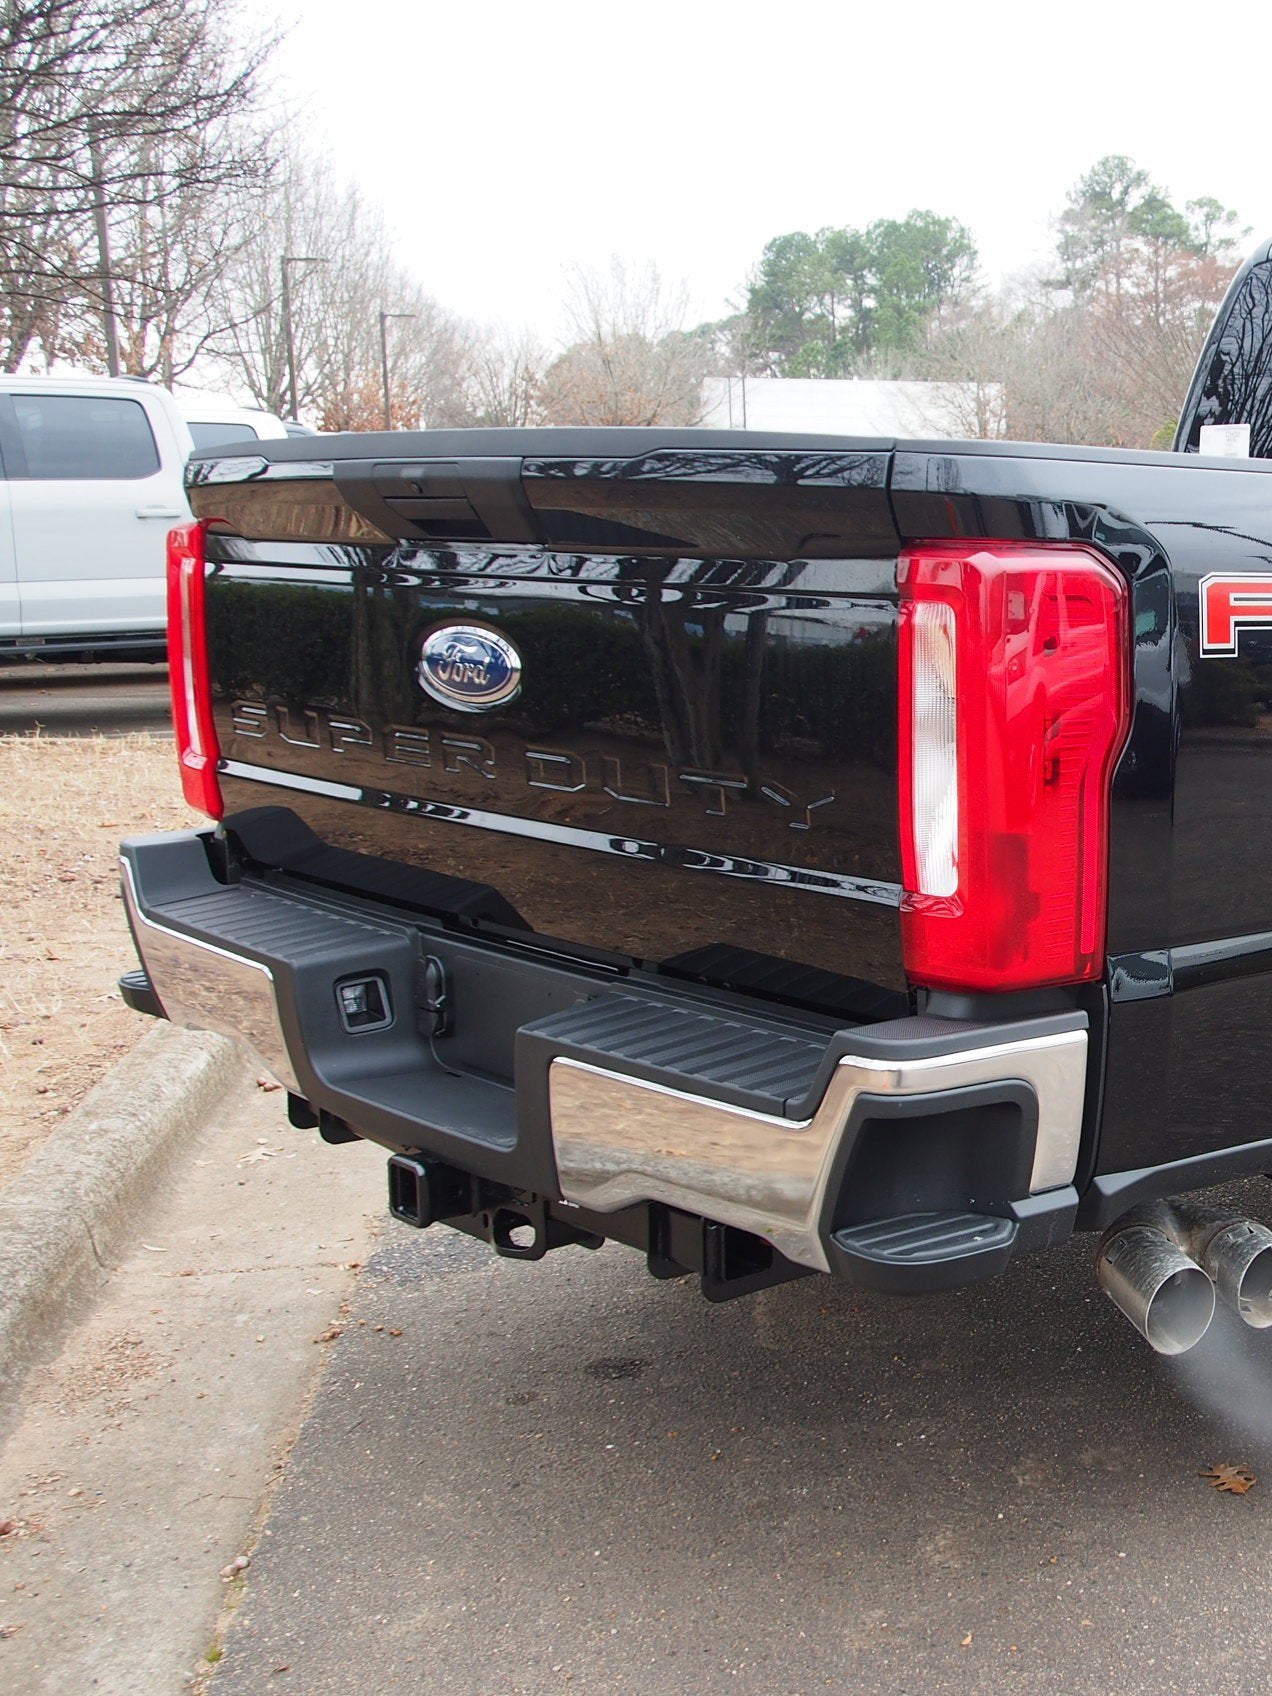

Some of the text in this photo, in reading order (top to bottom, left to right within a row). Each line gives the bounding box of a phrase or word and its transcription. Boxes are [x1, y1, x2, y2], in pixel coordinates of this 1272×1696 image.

[437, 641, 490, 686] Ford
[230, 699, 836, 830] SUPER DUTY
